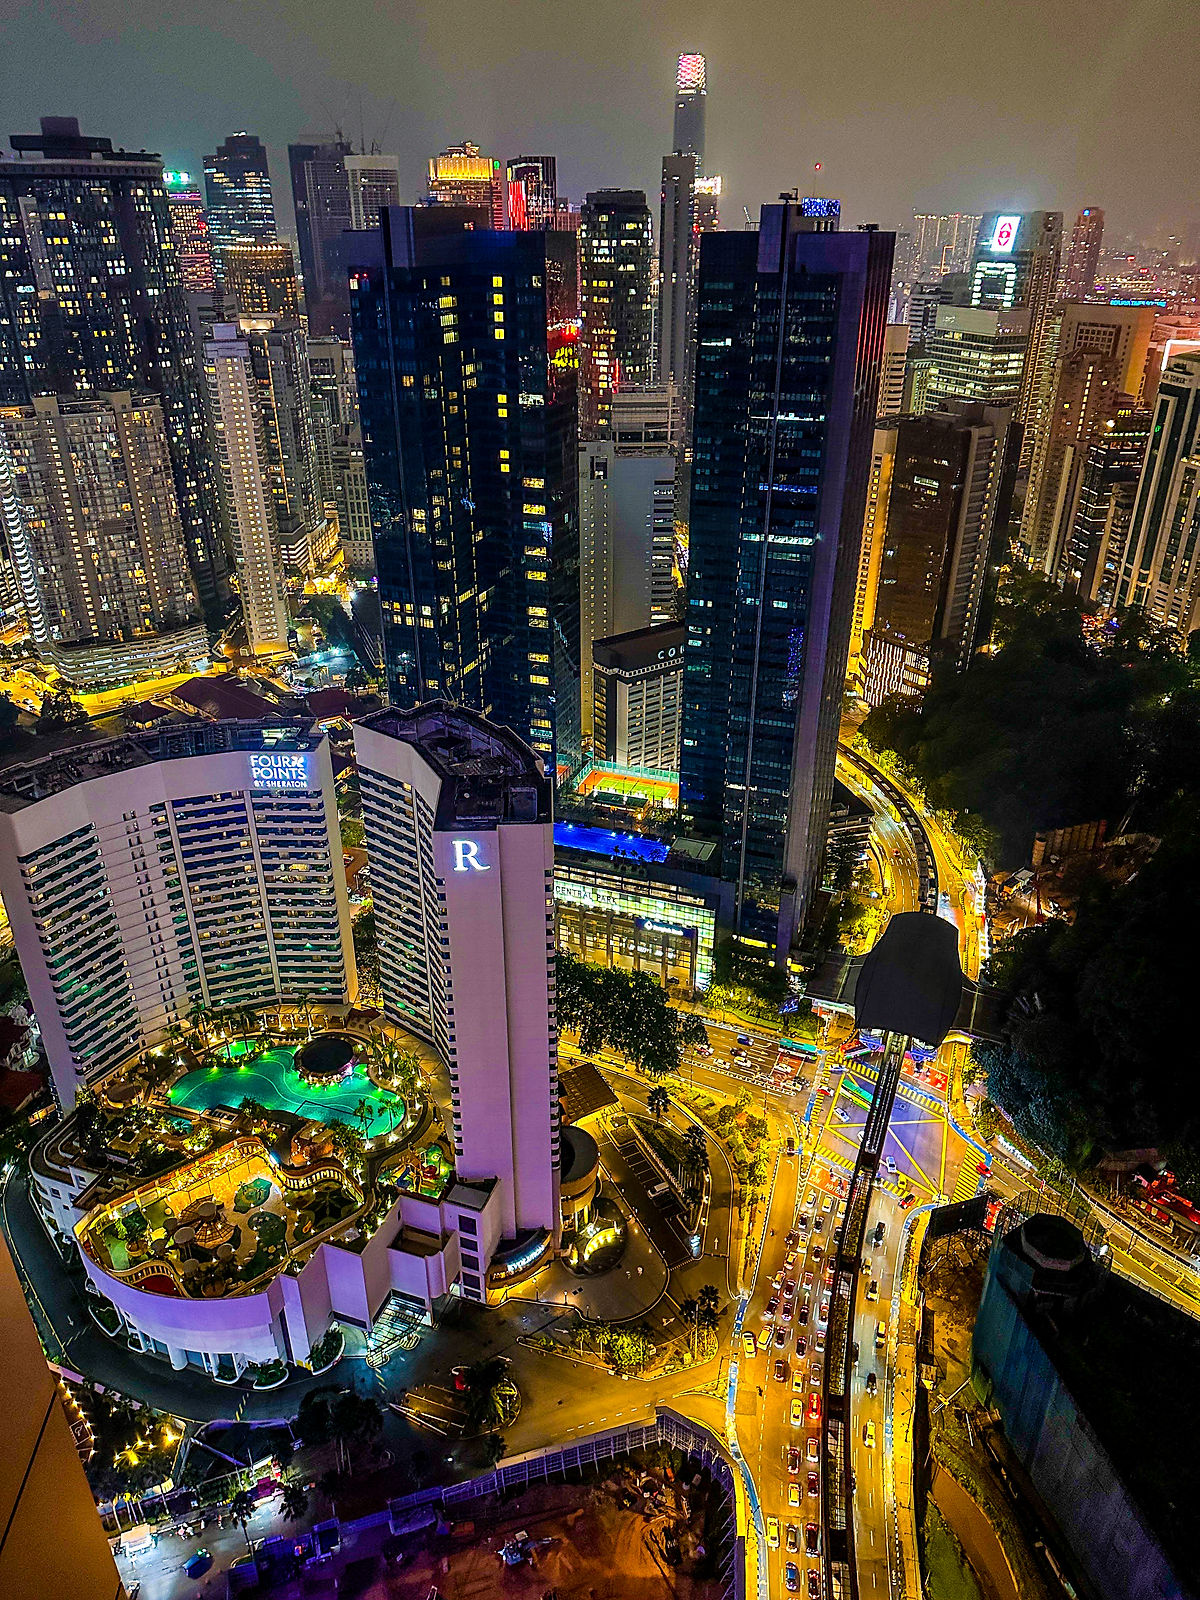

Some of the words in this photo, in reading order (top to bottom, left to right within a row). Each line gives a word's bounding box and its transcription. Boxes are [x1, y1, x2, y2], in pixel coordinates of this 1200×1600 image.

[250, 755, 292, 768] FOUR
[252, 767, 307, 780] POINTS
[253, 780, 264, 788] BY
[266, 780, 307, 788] SHERATON
[451, 840, 491, 871] R
[555, 885, 593, 900] CENTRAL
[596, 893, 618, 905] PARK
